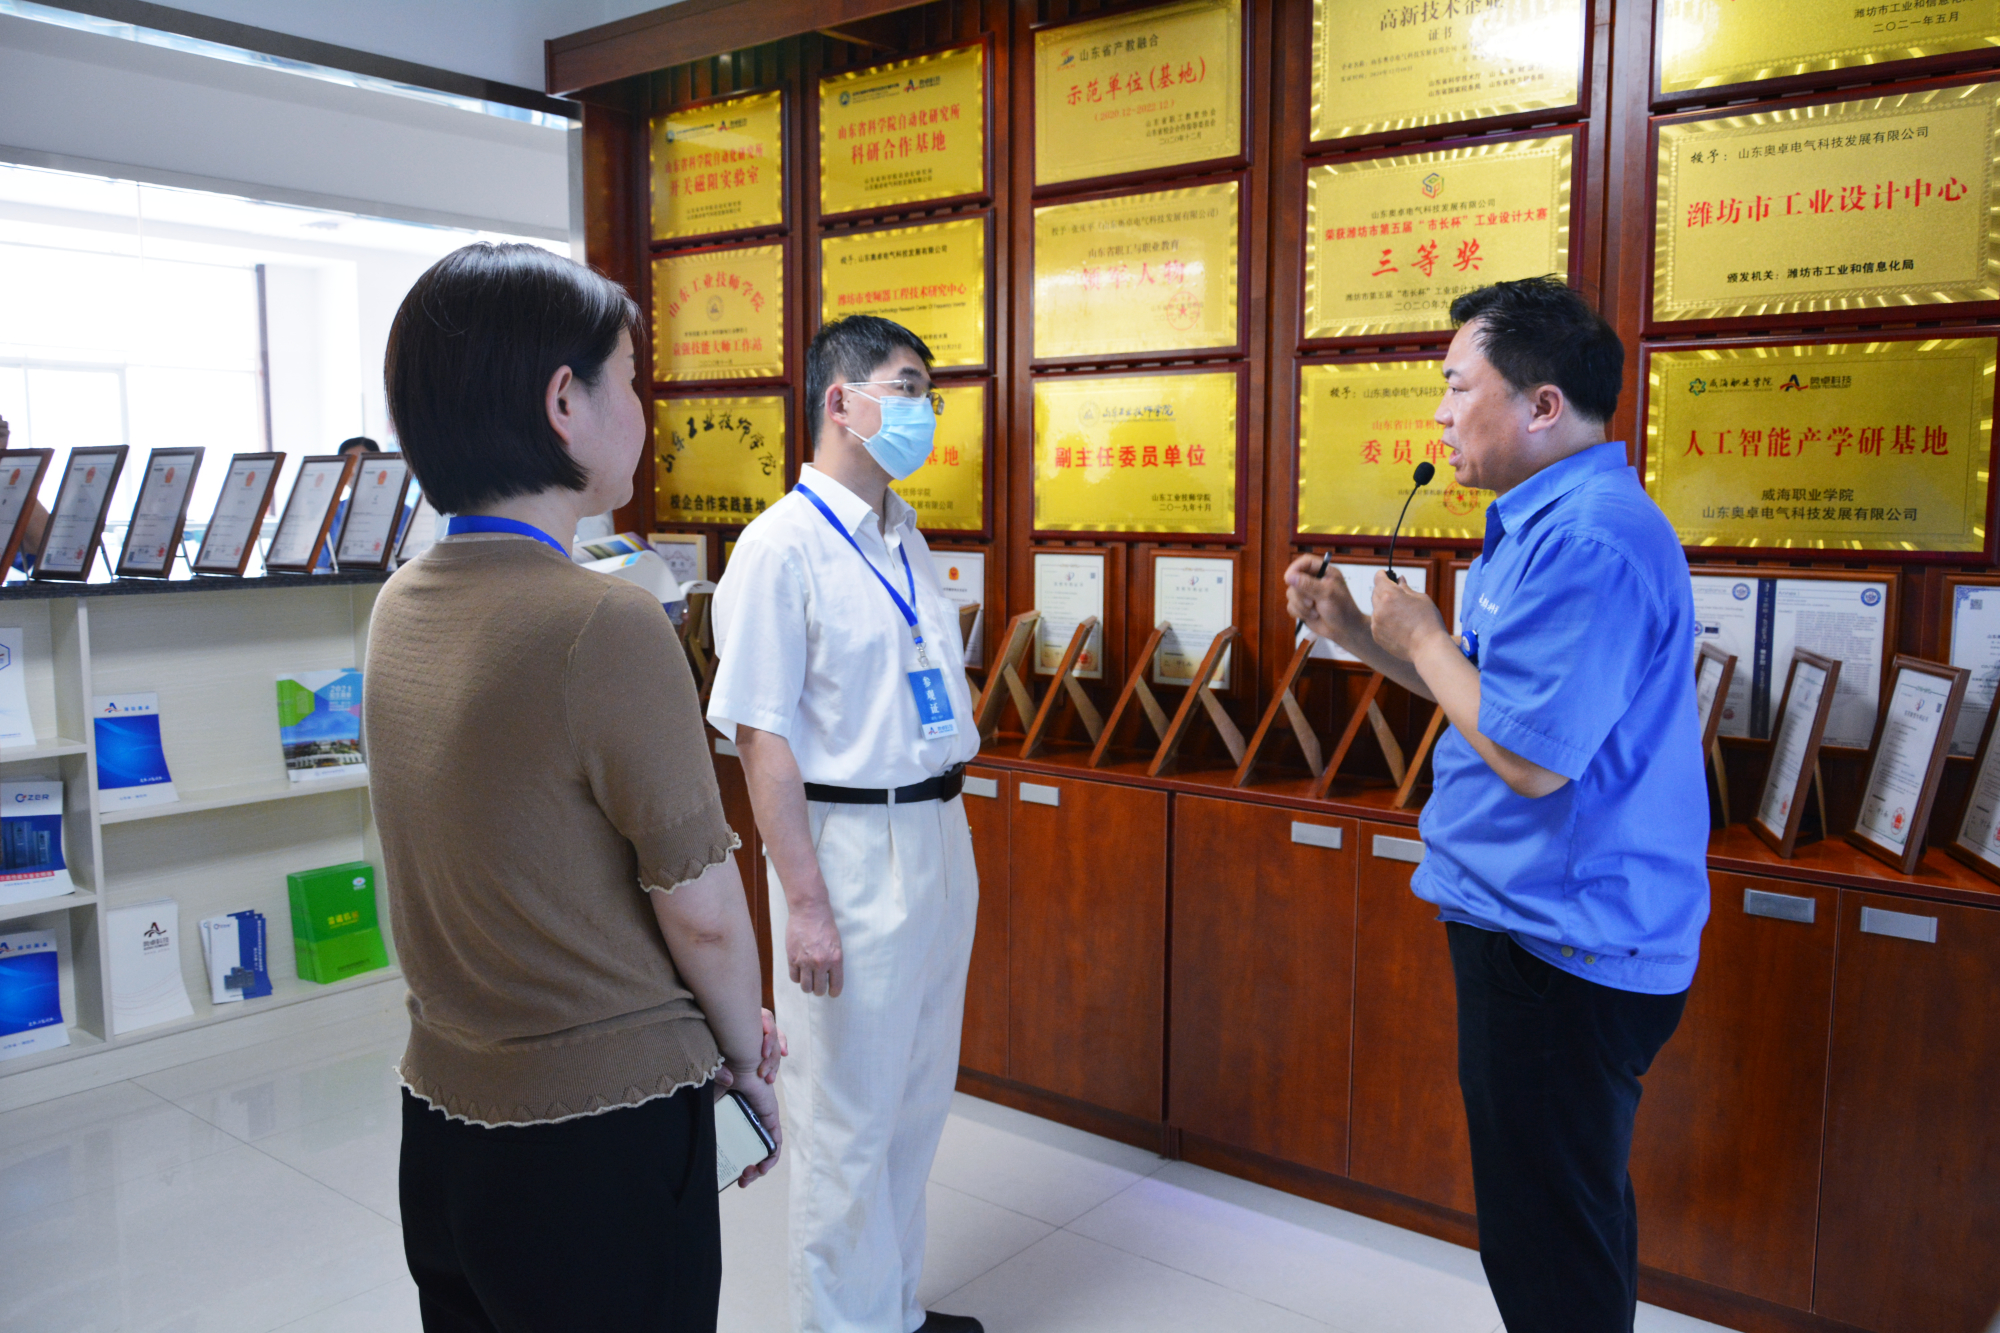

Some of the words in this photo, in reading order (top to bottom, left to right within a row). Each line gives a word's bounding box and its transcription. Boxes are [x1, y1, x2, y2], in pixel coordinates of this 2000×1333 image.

[1854, 0, 1974, 18] 潍坊市工业和信息
[1428, 26, 1452, 41] 证书
[1079, 33, 1159, 62] 山东省产教融合
[838, 103, 960, 140] 山东省科学院自动化研究所
[852, 130, 946, 165] 科研合作基地
[1738, 126, 1929, 160] 山东奥卓电气科技发展有限公司
[669, 165, 759, 197] 开关磁阻实验室
[1371, 198, 1496, 219] 山东奥卓电气科技发展有限公司
[1686, 176, 1968, 228] 潍坊市工业设计中心
[1371, 238, 1484, 278] 三等奖
[1787, 258, 1914, 280] 潍坊市工业和信息化局
[1082, 259, 1185, 291] 领军人物
[838, 282, 967, 306] 潍坊市变频器工程技术研究中心
[1810, 375, 1852, 385] 奥卓科技
[1363, 385, 1449, 399] 山东奥卓电气科技发
[1682, 424, 1950, 458] 人工智能产学研基地
[1055, 444, 1206, 469] 副主任委员单位
[893, 487, 931, 497] 业技师学院
[1151, 493, 1211, 502] 山东工业技师学院
[1761, 487, 1854, 502] 威海职业学院
[671, 494, 766, 513] 校企合作实践基地
[908, 501, 954, 510] 发展有限公司
[1701, 505, 1917, 522] 山东奥卓电气科技发展有限公司
